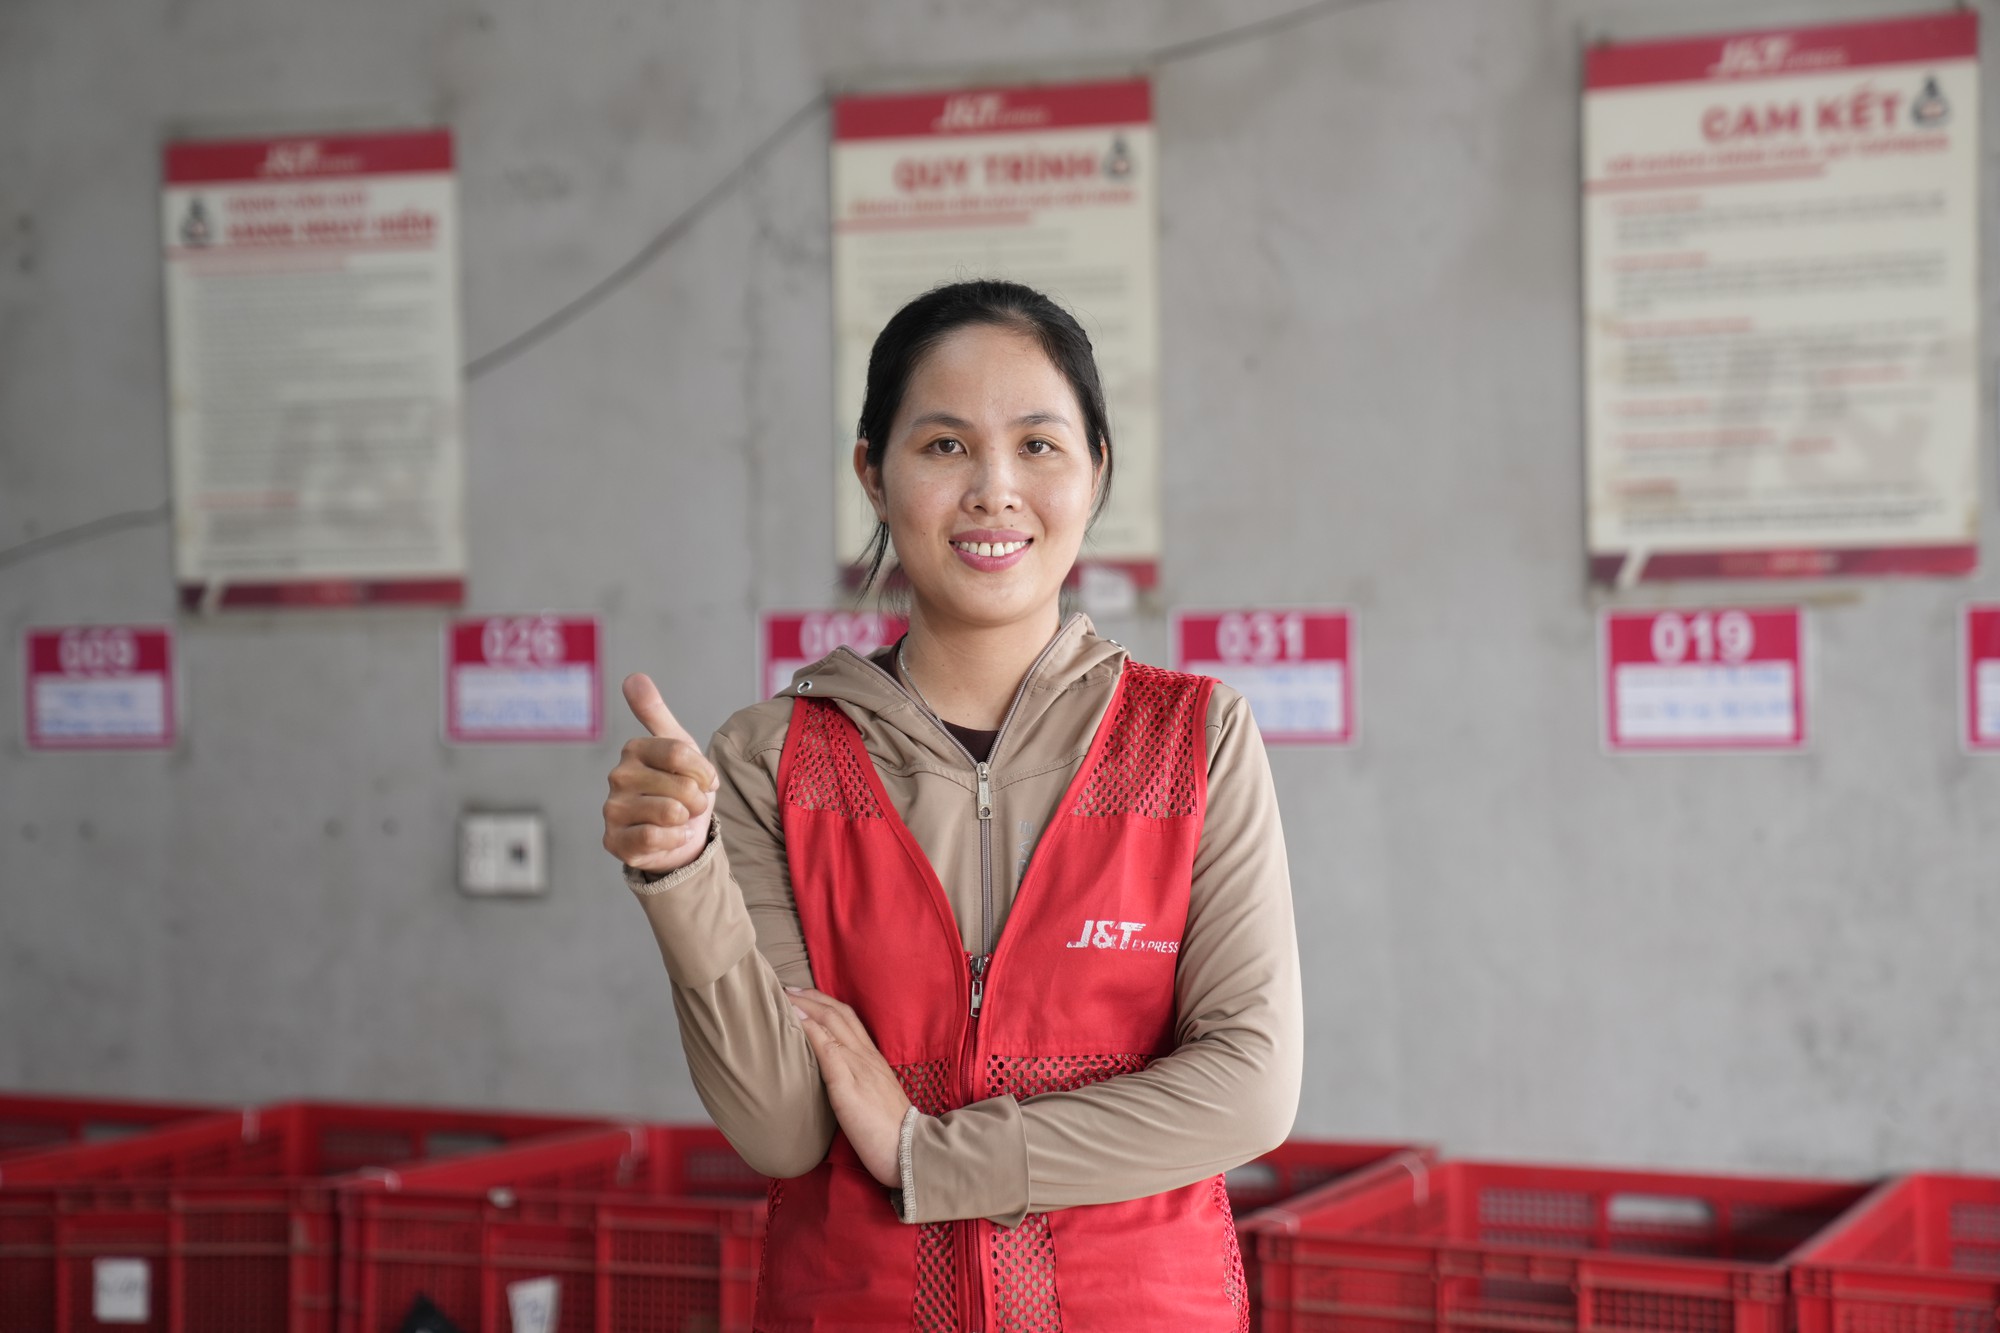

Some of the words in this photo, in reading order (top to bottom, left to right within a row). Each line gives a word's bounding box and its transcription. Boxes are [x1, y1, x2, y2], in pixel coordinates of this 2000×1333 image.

[1701, 104, 1803, 143] CAM
[1815, 84, 1904, 132] KẾT
[893, 155, 971, 193] QUY
[483, 618, 562, 668] 026
[1217, 613, 1304, 664] 031
[1652, 612, 1753, 664] 019
[1066, 920, 1146, 949] J&T
[1132, 940, 1179, 953] EXPRESS
